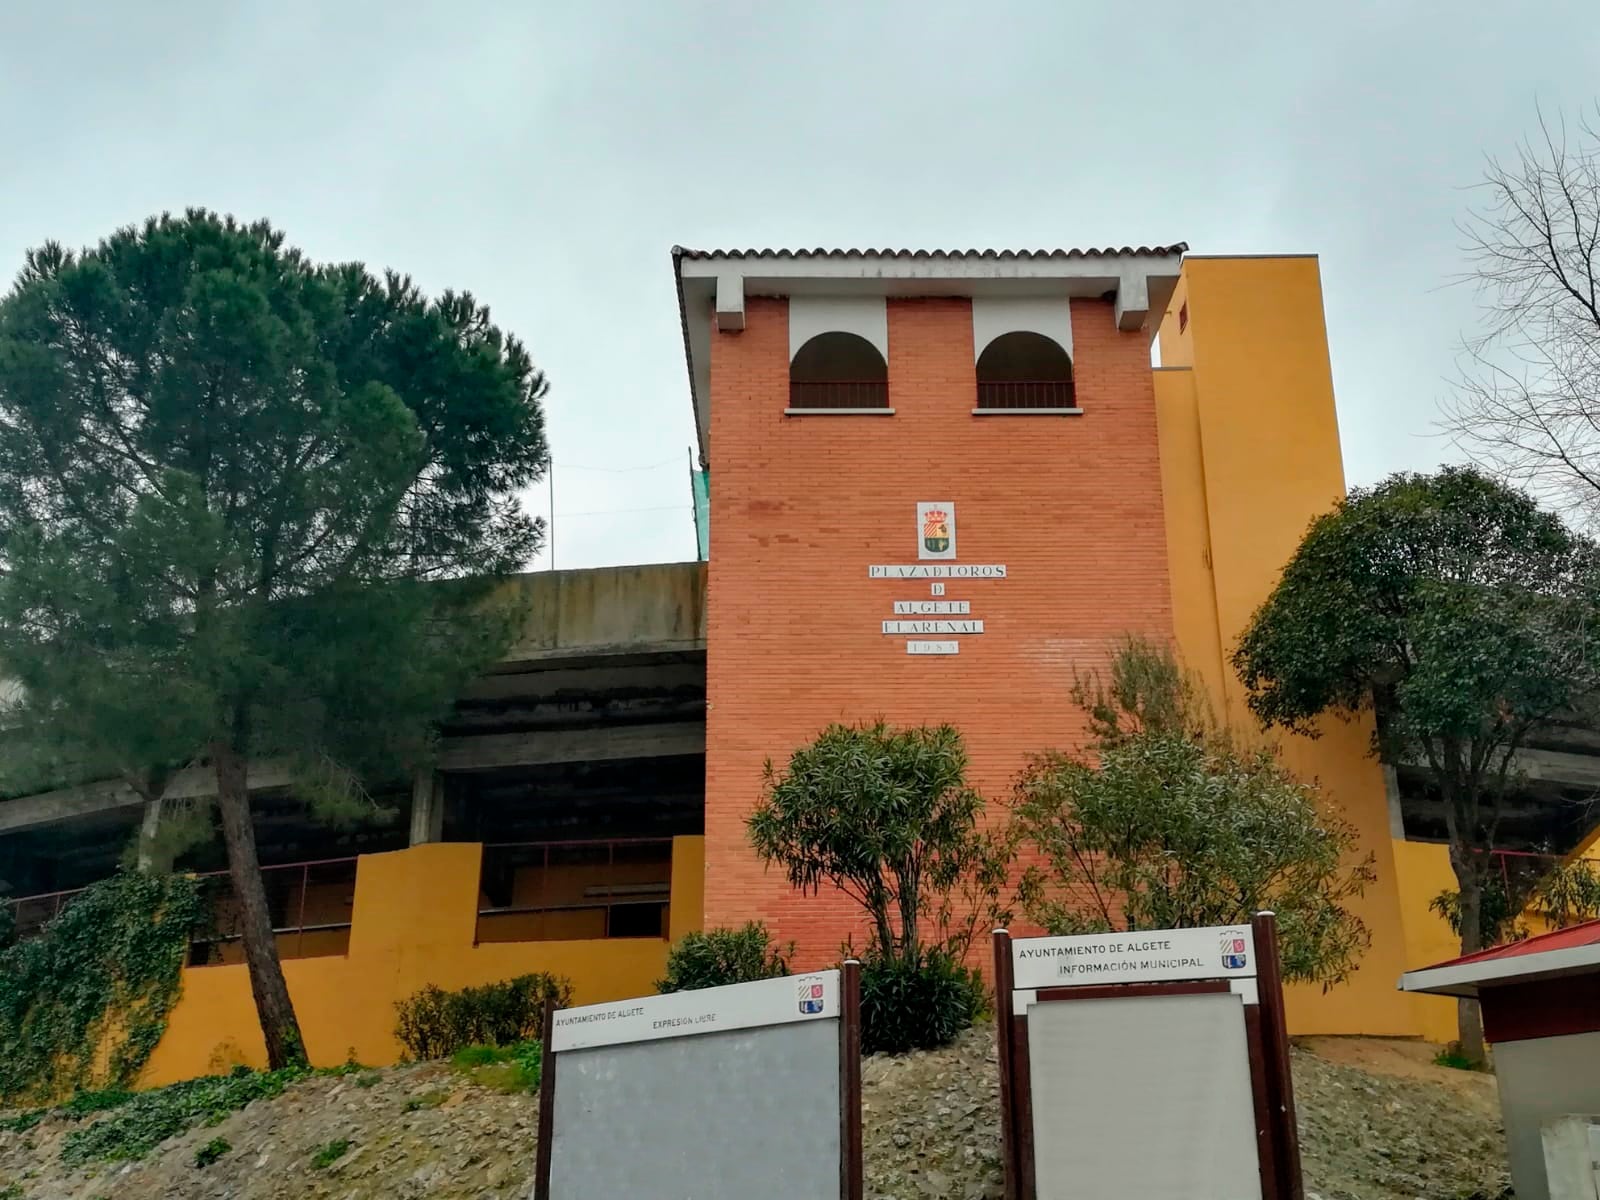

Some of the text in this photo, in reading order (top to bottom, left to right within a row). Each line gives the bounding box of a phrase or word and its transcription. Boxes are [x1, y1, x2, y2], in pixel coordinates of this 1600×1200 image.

[897, 602, 967, 613] ALGETE
[1019, 940, 1171, 959] AYUNTAMIENTO DE ALGETE
[1059, 957, 1204, 975] INFORMACIÓN MUNICIPAL
[556, 1007, 644, 1027] AYUNTAMIENTO DE ALGETE
